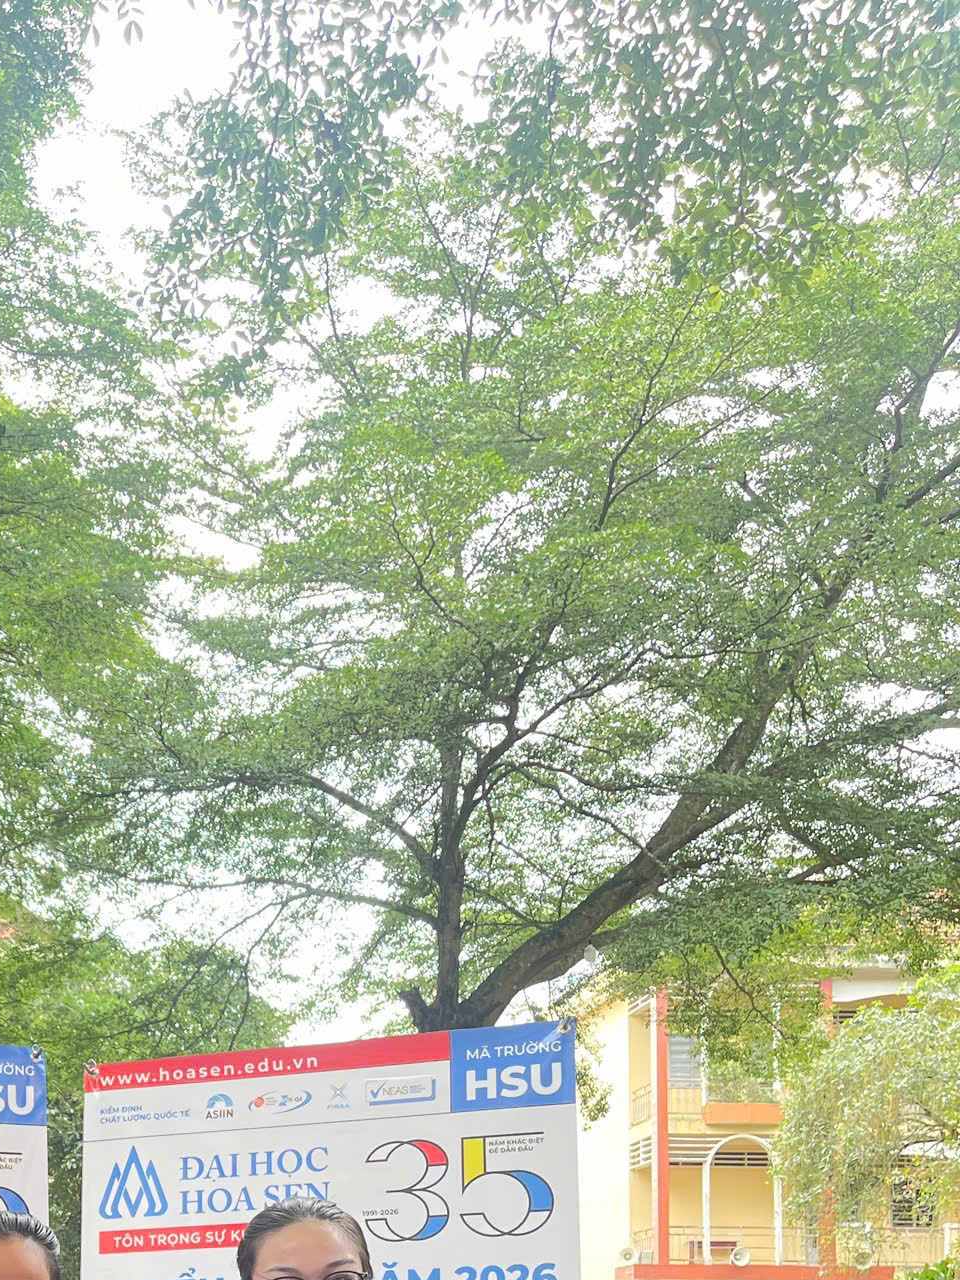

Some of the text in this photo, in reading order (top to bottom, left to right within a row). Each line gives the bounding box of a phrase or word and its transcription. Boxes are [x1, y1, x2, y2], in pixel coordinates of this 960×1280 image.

[466, 1040, 562, 1061] MÃ TRƯỜNG
[100, 1056, 319, 1087] www.hoasen.edu.vn
[465, 1062, 563, 1101] HSU
[382, 1084, 409, 1096] NEAS
[99, 1114, 126, 1125] CHẤT
[205, 1109, 234, 1121] ASIIN
[506, 1137, 528, 1146] KHÁC
[179, 1146, 329, 1183] ĐẠI HỌC
[365, 1131, 555, 1242] 35
[179, 1185, 256, 1215] HOA
[361, 1208, 399, 1217] 1991-2026
[113, 1232, 145, 1249] TÔN
[149, 1230, 201, 1247] TRỌNG
[205, 1228, 226, 1246] SỰ
